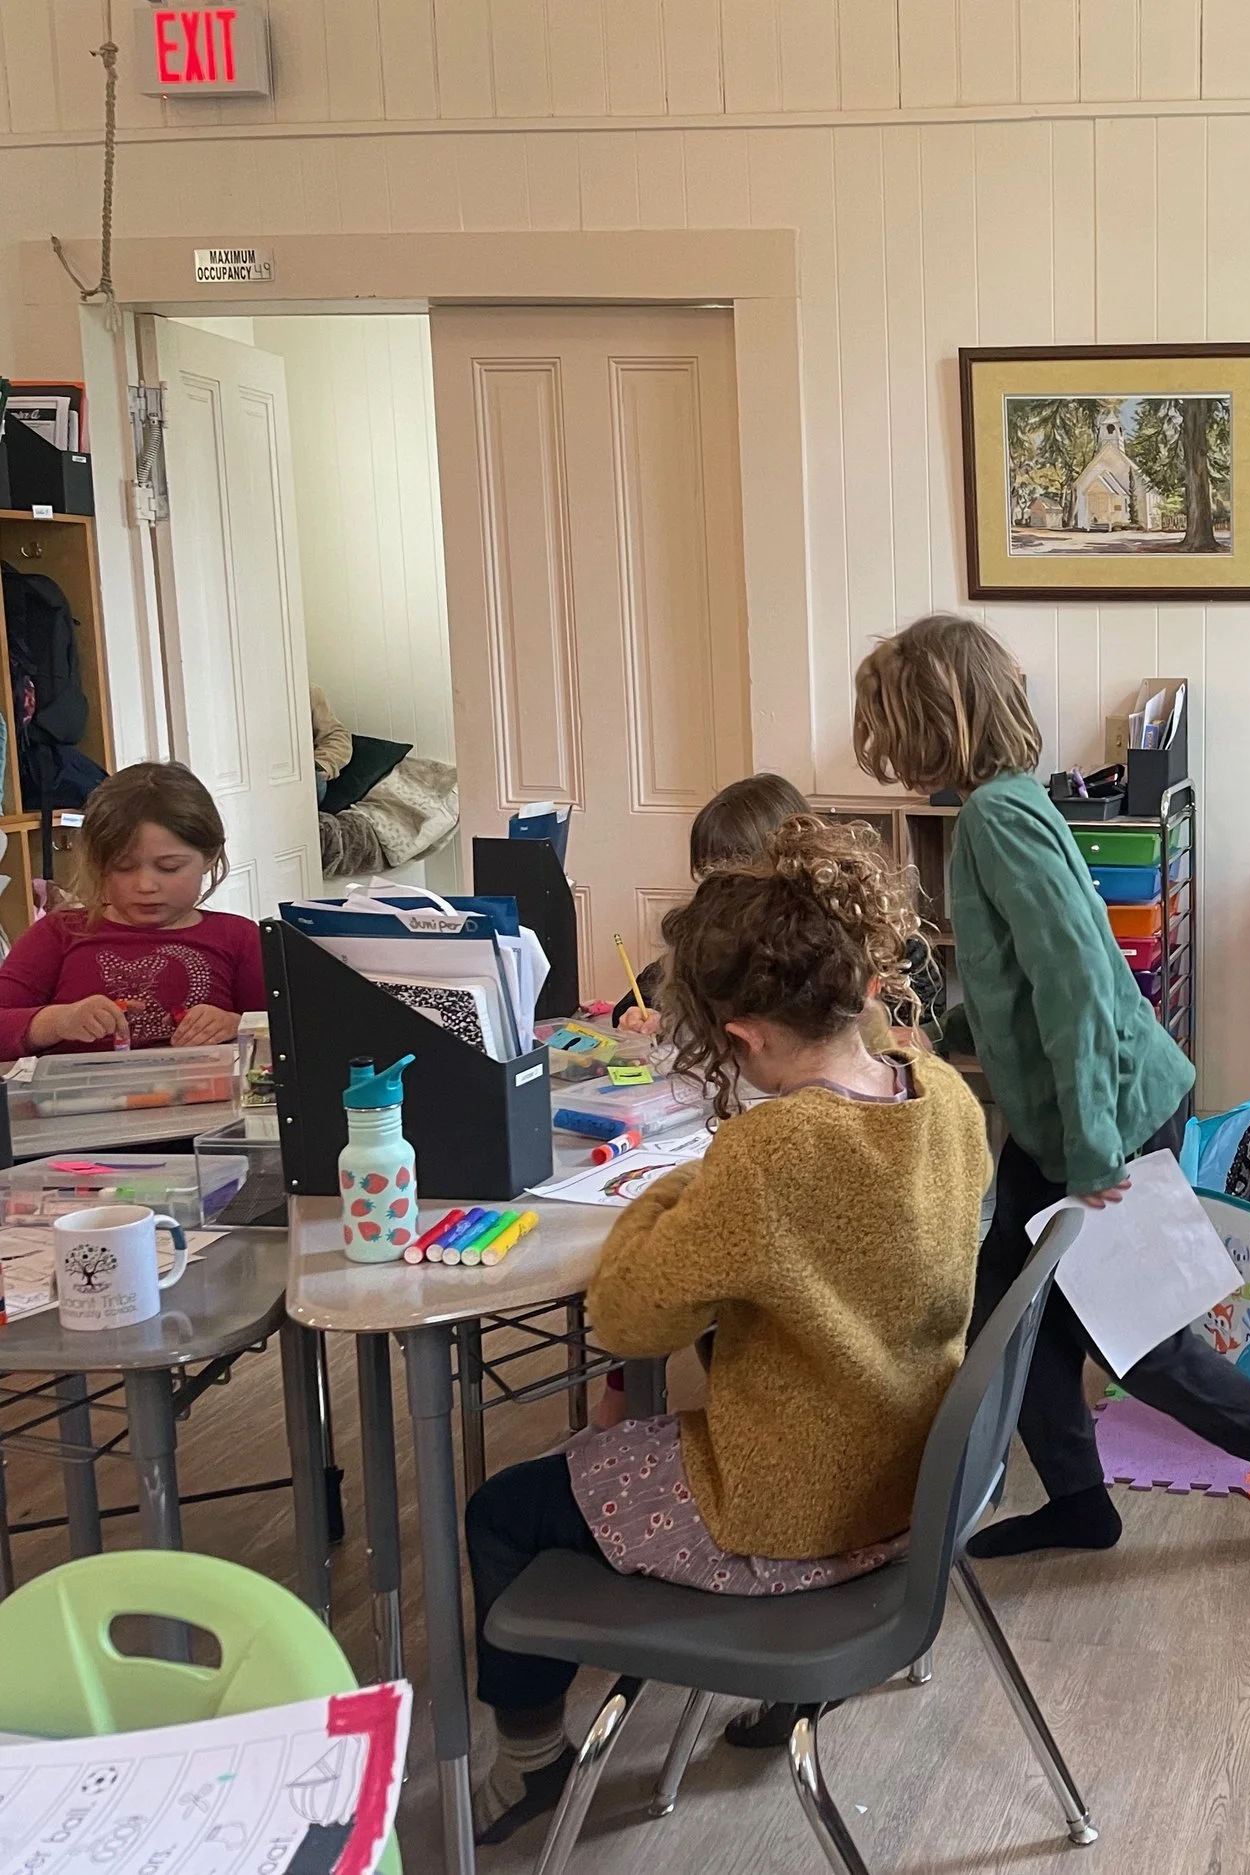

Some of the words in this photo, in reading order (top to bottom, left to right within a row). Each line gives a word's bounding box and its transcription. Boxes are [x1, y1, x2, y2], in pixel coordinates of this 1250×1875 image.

[155, 10, 236, 83] EXIT
[209, 250, 256, 264] MAXIMUM
[197, 266, 251, 280] OCCUPANCY
[254, 262, 271, 279] 49
[409, 916, 461, 932] Juniper
